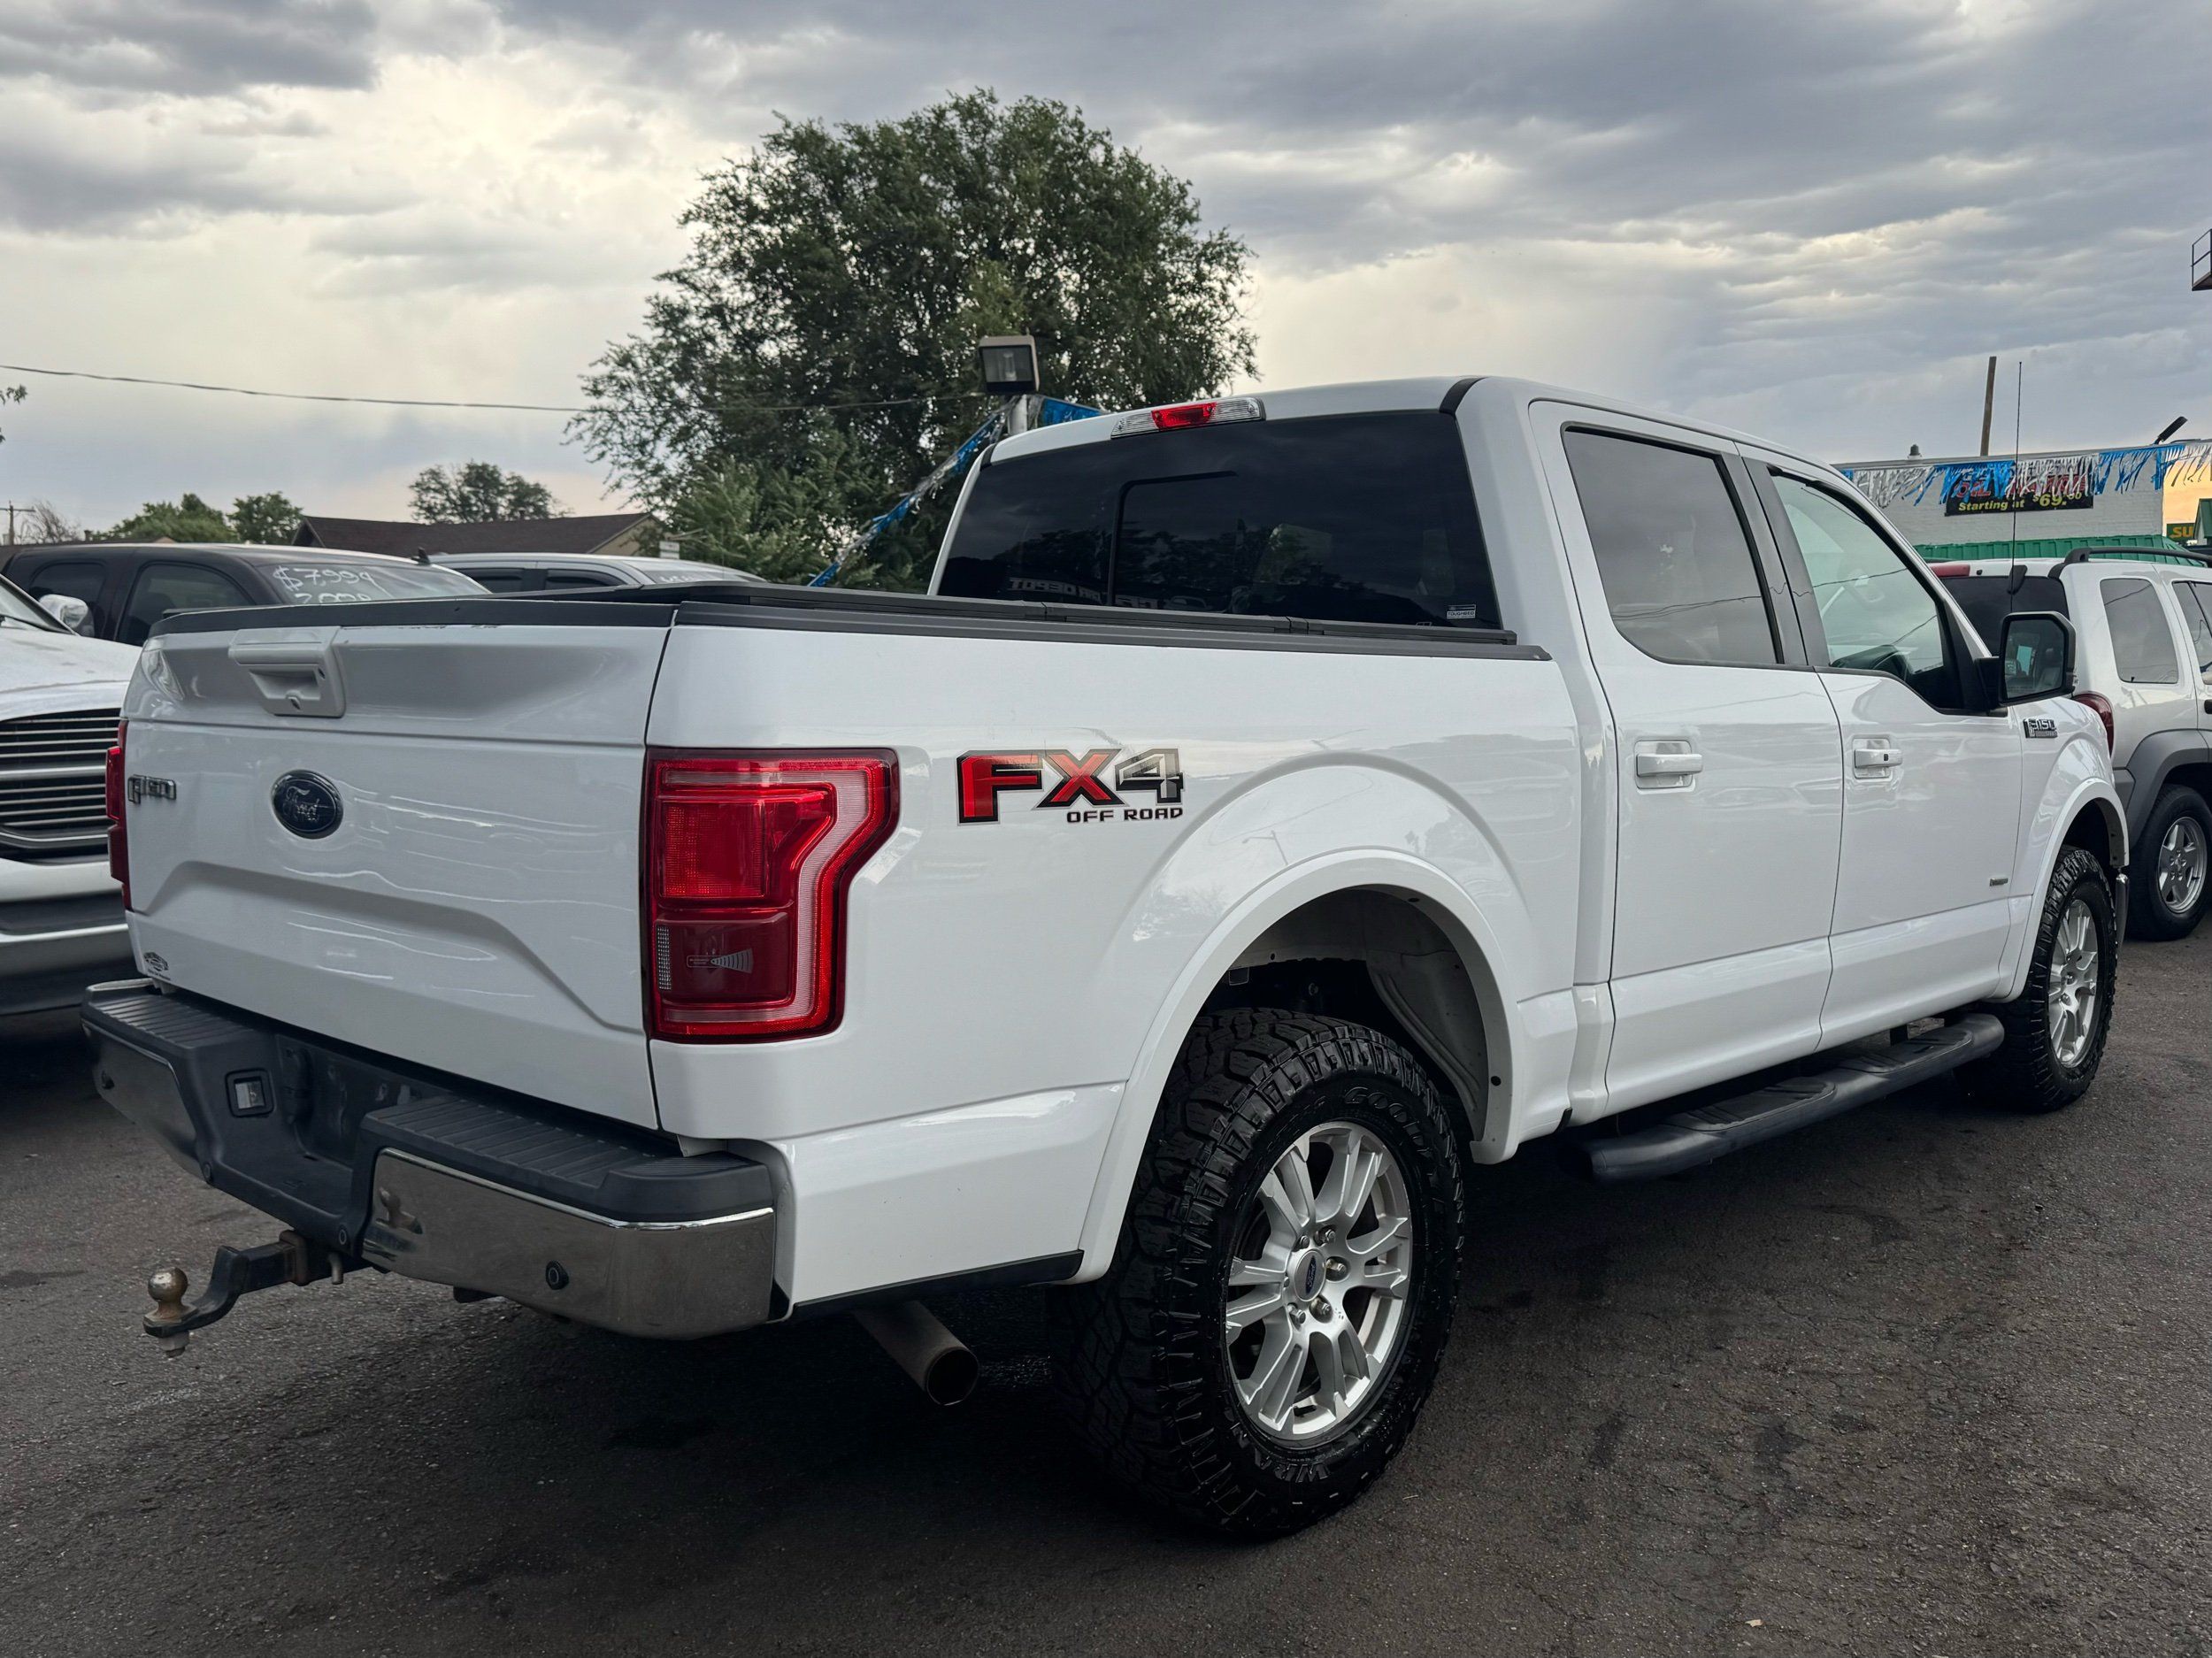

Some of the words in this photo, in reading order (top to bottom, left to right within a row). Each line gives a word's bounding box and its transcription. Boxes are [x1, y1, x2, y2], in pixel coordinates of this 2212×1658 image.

[1958, 500, 2008, 511] Starting
[956, 748, 1184, 825] FX4
[1066, 810, 1114, 824] OFF
[1124, 808, 1183, 821] ROAD
